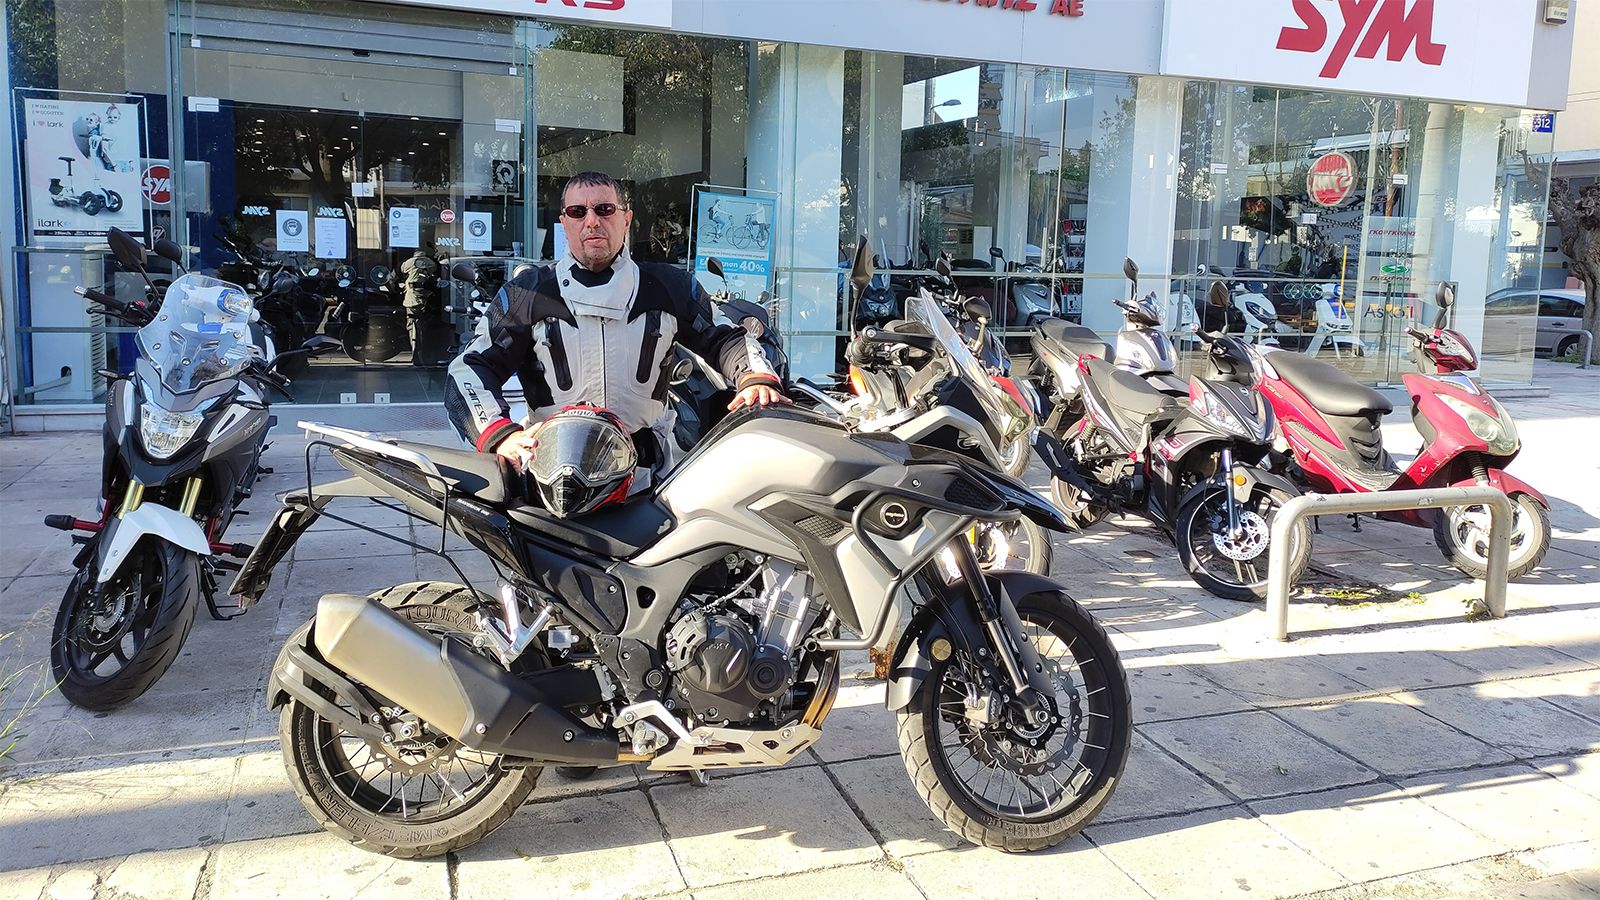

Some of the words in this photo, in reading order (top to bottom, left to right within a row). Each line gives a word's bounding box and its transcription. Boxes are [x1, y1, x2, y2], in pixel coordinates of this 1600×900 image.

[1275, 0, 1447, 79] SYM
[38, 218, 64, 228] ilark
[740, 260, 765, 273] 40%
